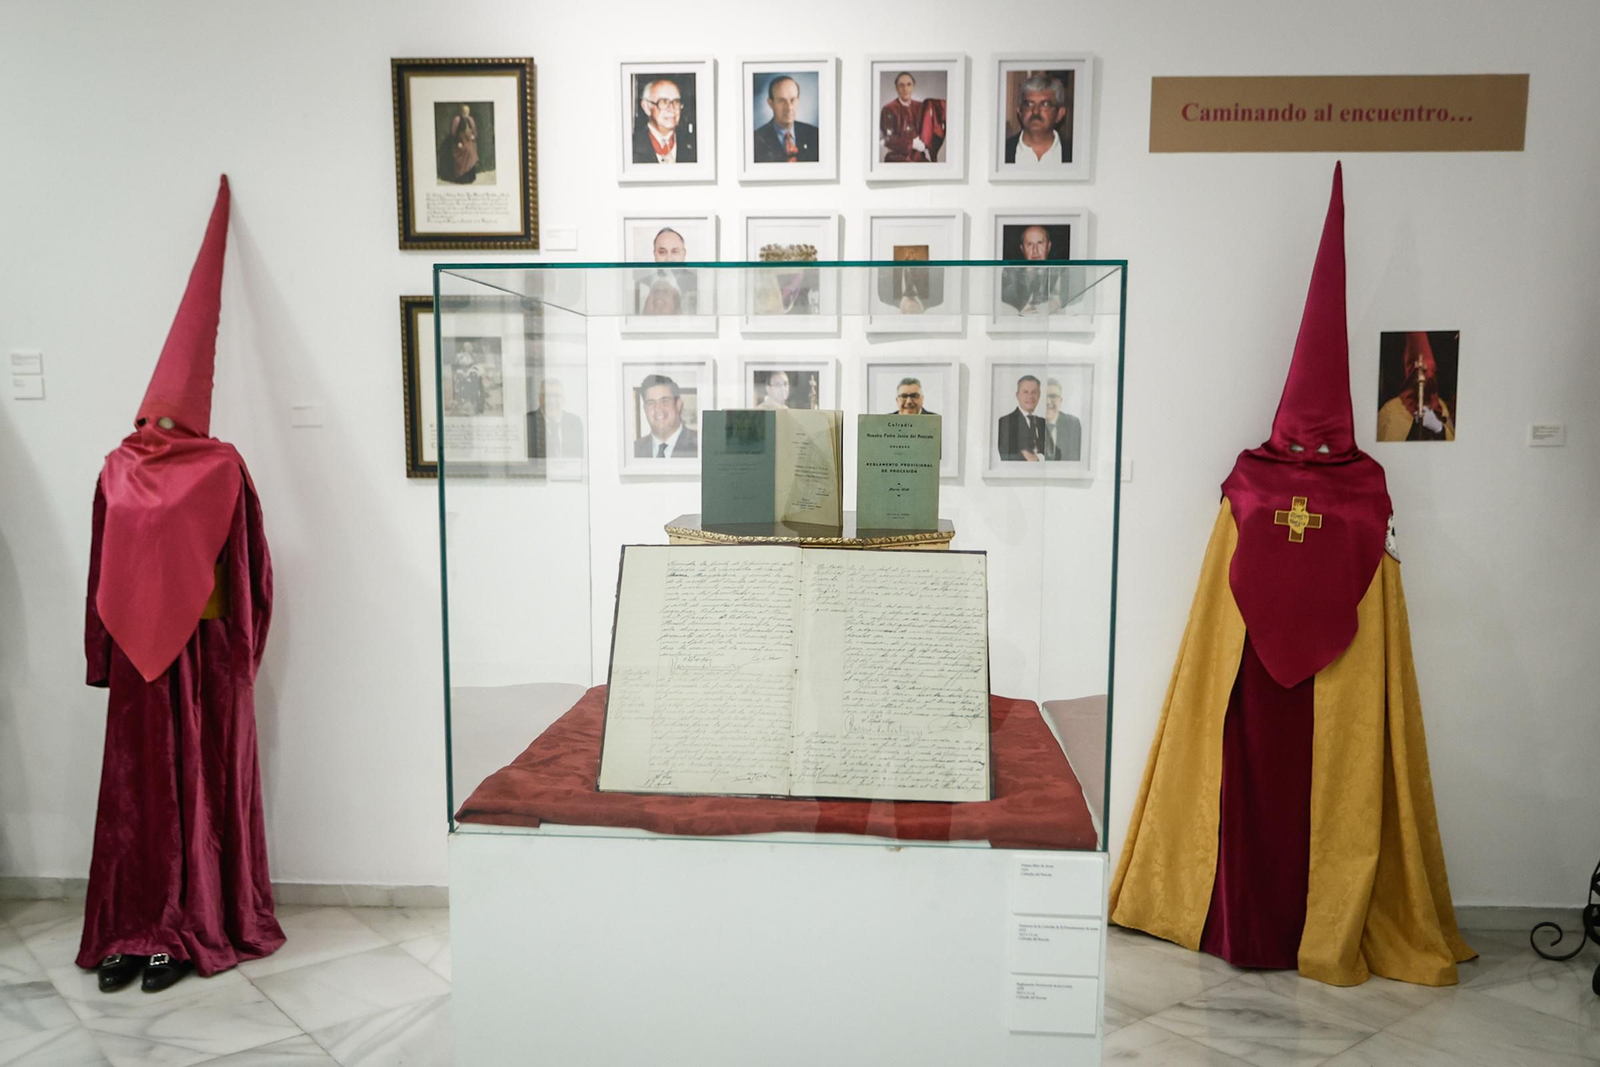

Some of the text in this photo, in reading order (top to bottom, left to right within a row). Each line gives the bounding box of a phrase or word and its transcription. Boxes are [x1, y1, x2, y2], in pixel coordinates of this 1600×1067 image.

[1181, 101, 1474, 124] Caminando al encuentro...
